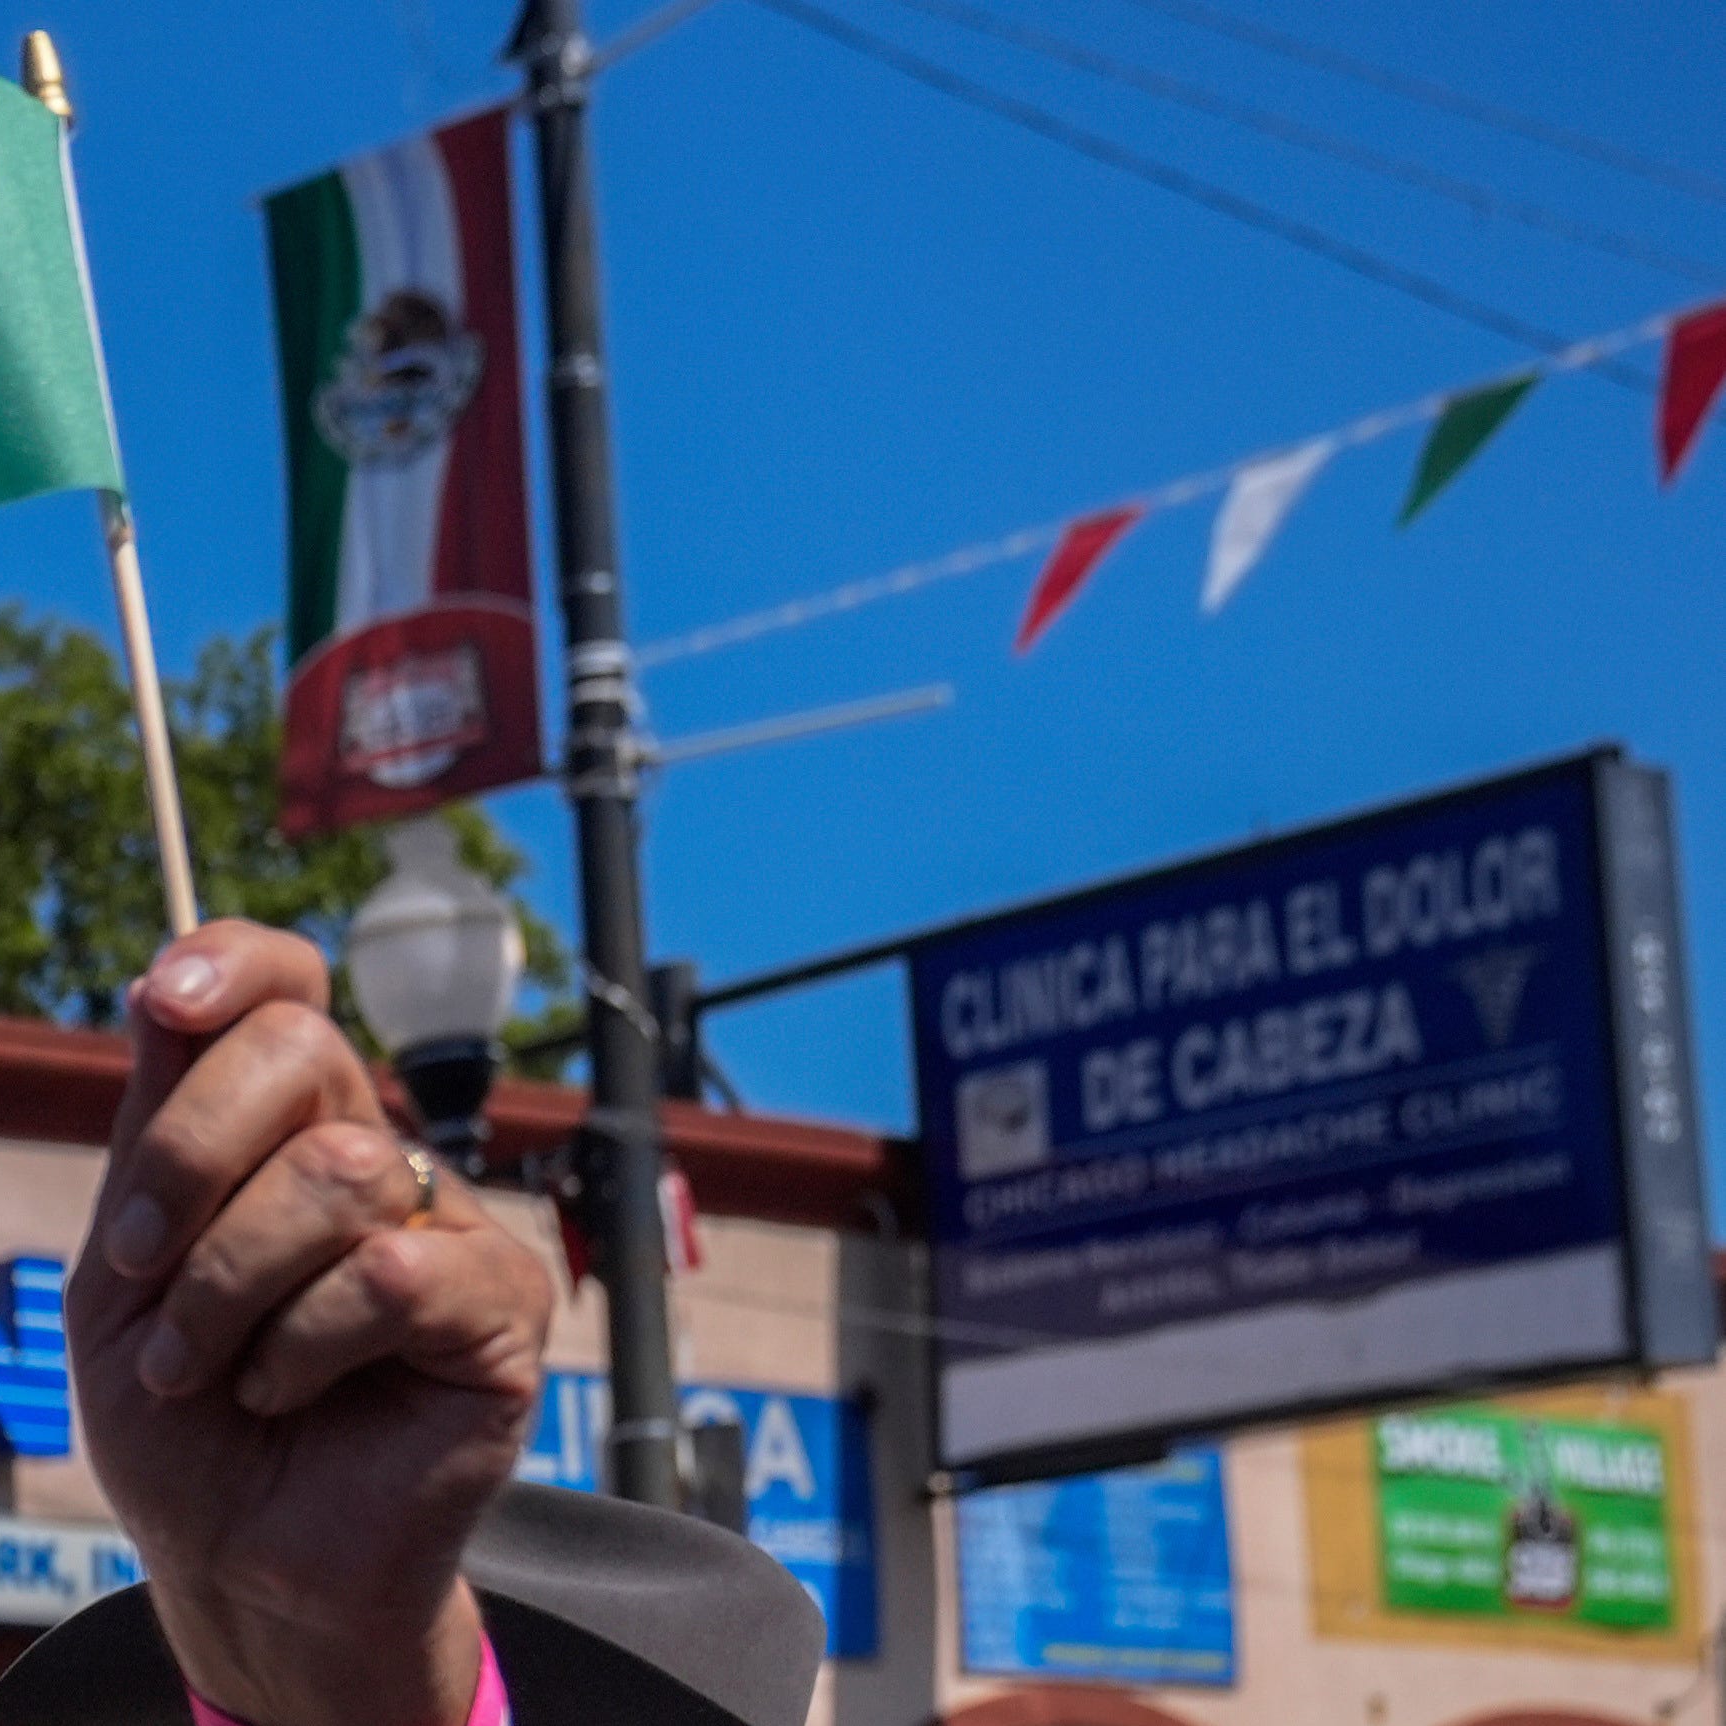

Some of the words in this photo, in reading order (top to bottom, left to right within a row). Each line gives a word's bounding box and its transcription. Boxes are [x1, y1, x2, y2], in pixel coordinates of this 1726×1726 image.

[941, 935, 1135, 1060] CLINICA
[1140, 898, 1282, 1008] PARA
[1284, 880, 1359, 977] EL
[1361, 826, 1562, 956] DOLOR
[1081, 1036, 1163, 1132] DE
[1171, 982, 1424, 1109] CABEZA
